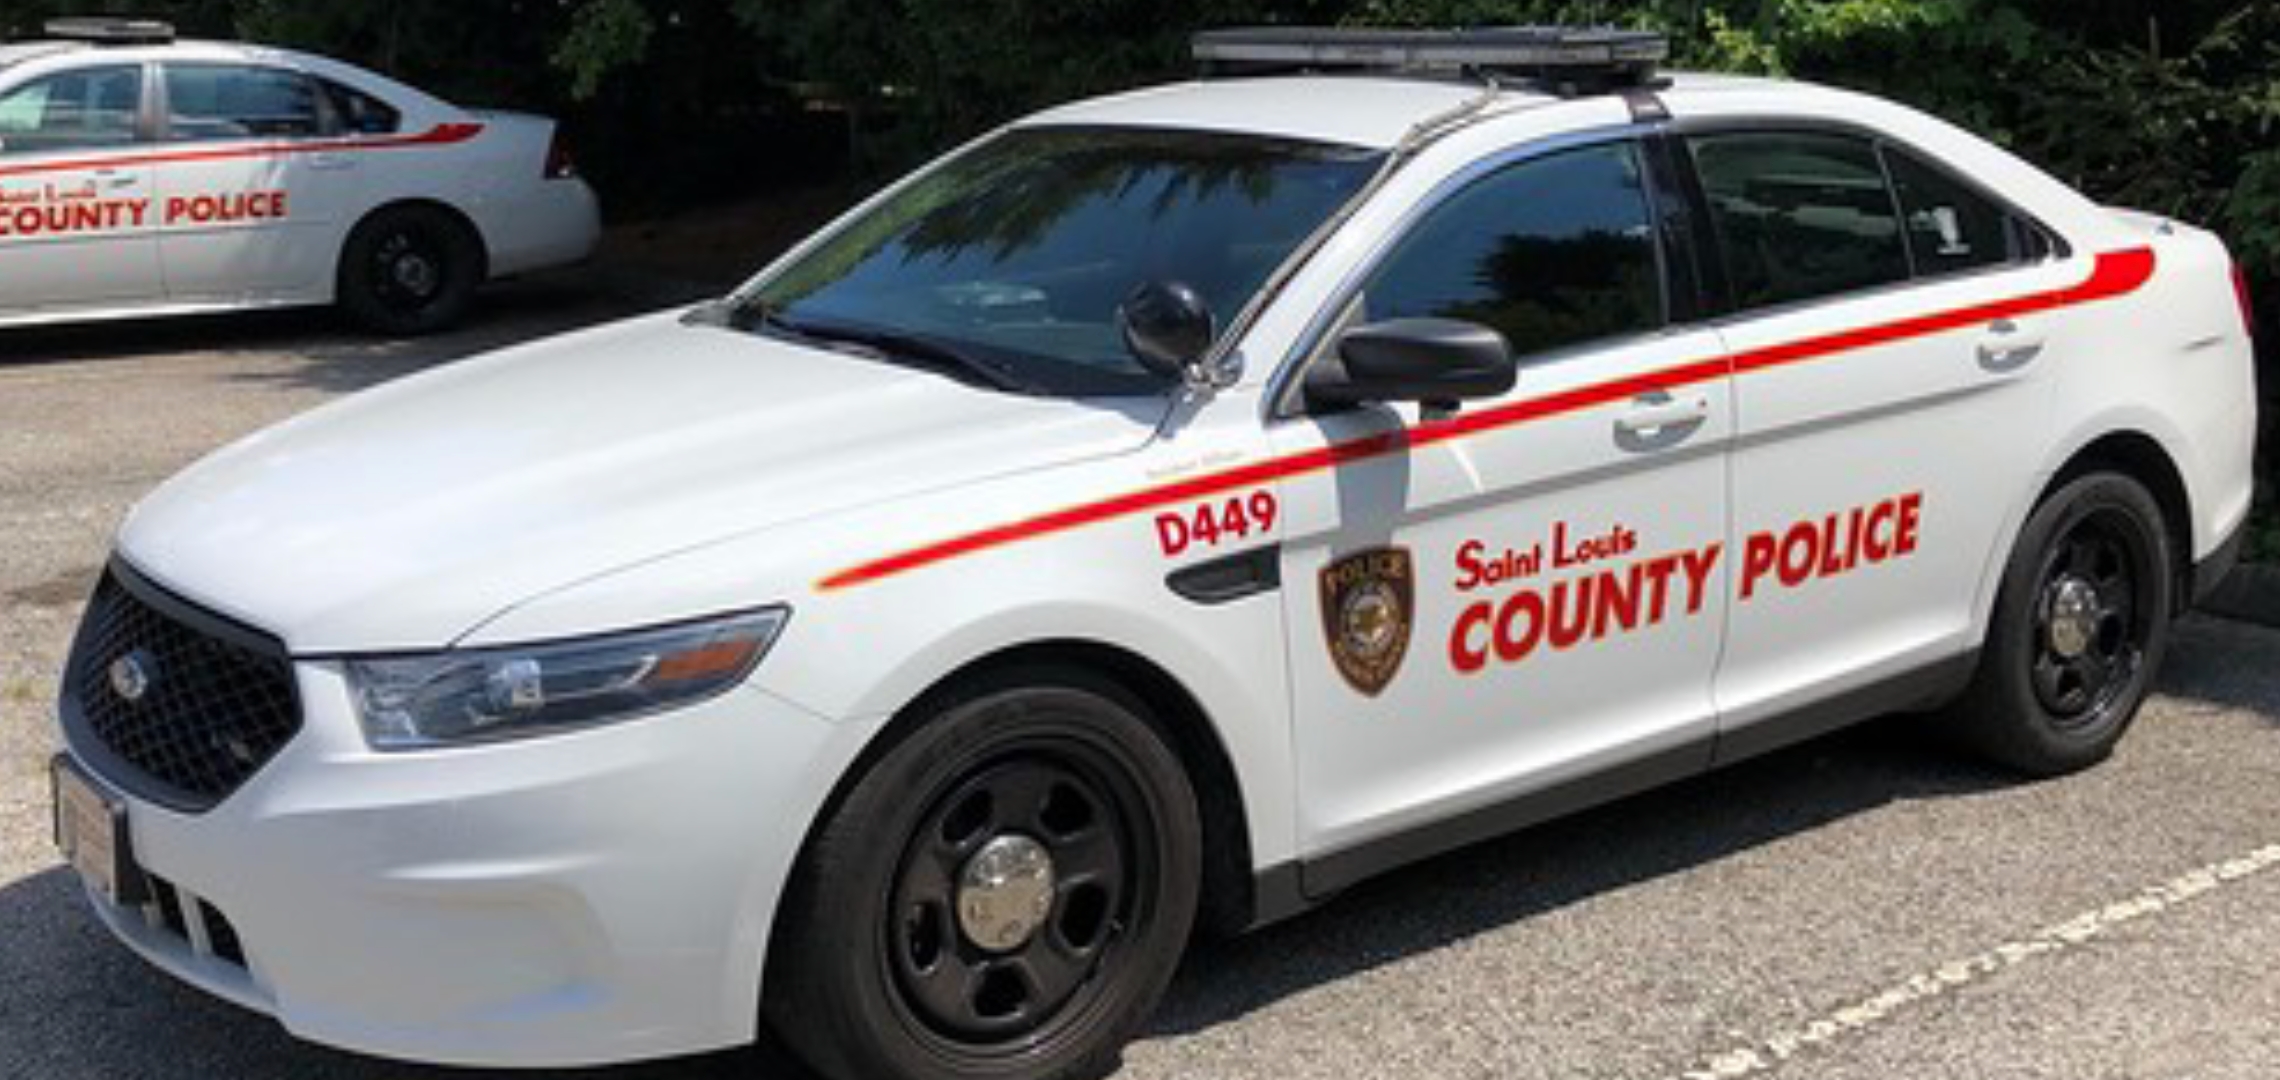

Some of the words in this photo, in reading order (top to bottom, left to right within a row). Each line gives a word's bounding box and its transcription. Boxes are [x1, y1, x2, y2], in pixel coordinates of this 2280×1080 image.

[165, 190, 287, 223] POLICE
[1155, 489, 1277, 558] D449
[1454, 539, 1542, 592] Saint
[1551, 521, 1638, 569] Louis
[1324, 555, 1405, 595] POLICE
[1447, 542, 1723, 674] COUNTY
[1738, 492, 1922, 600] POLICE
